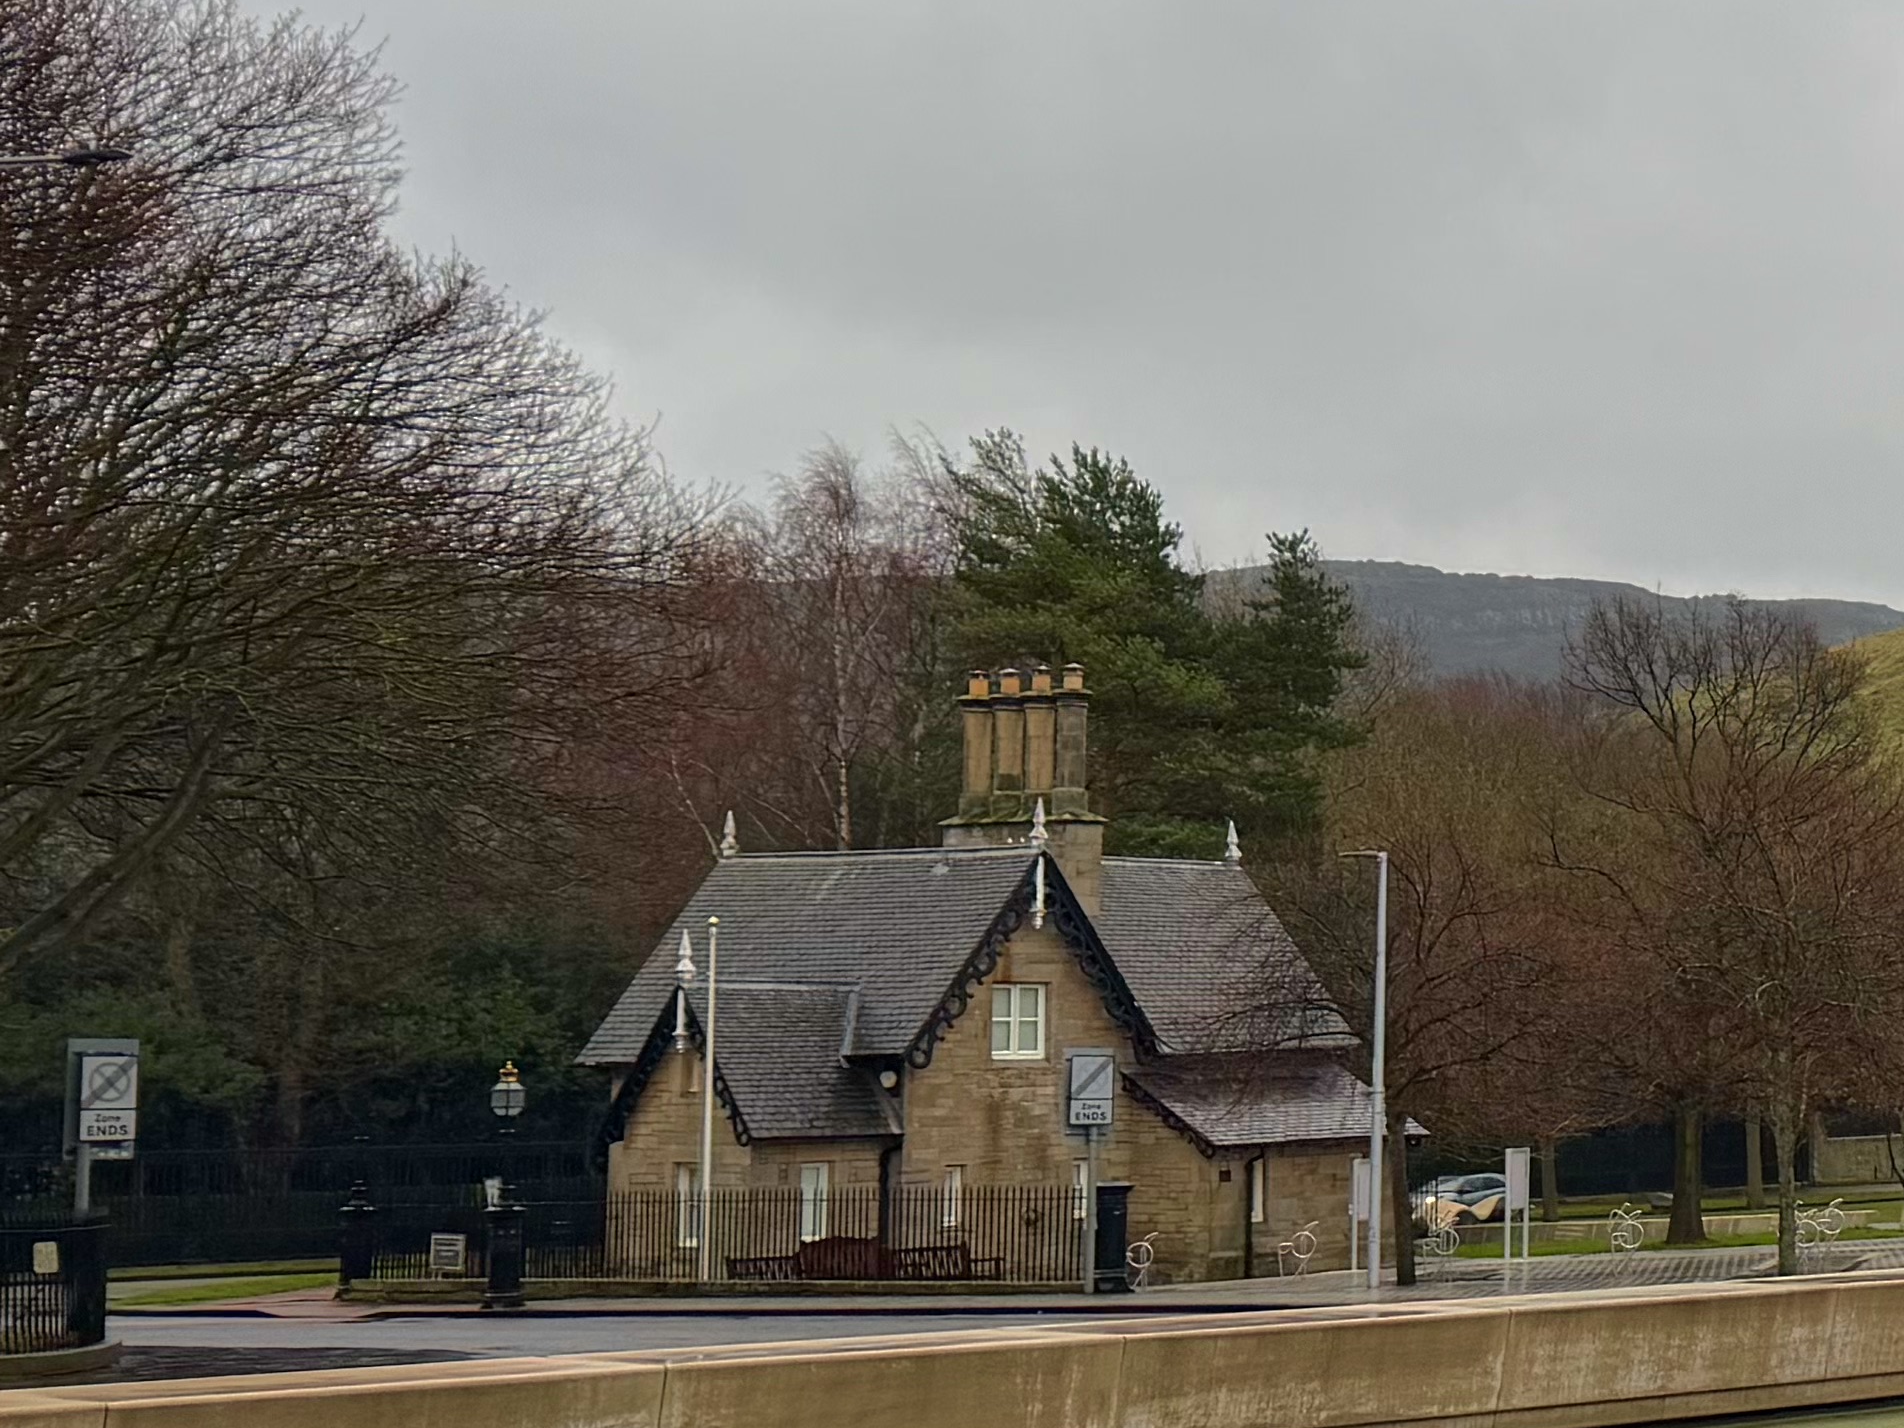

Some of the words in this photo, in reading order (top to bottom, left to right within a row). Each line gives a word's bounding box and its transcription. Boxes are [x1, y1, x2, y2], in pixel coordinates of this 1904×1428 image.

[94, 1114, 121, 1123] Zone
[1075, 1112, 1107, 1121] ENDS
[86, 1125, 128, 1136] ENDS
